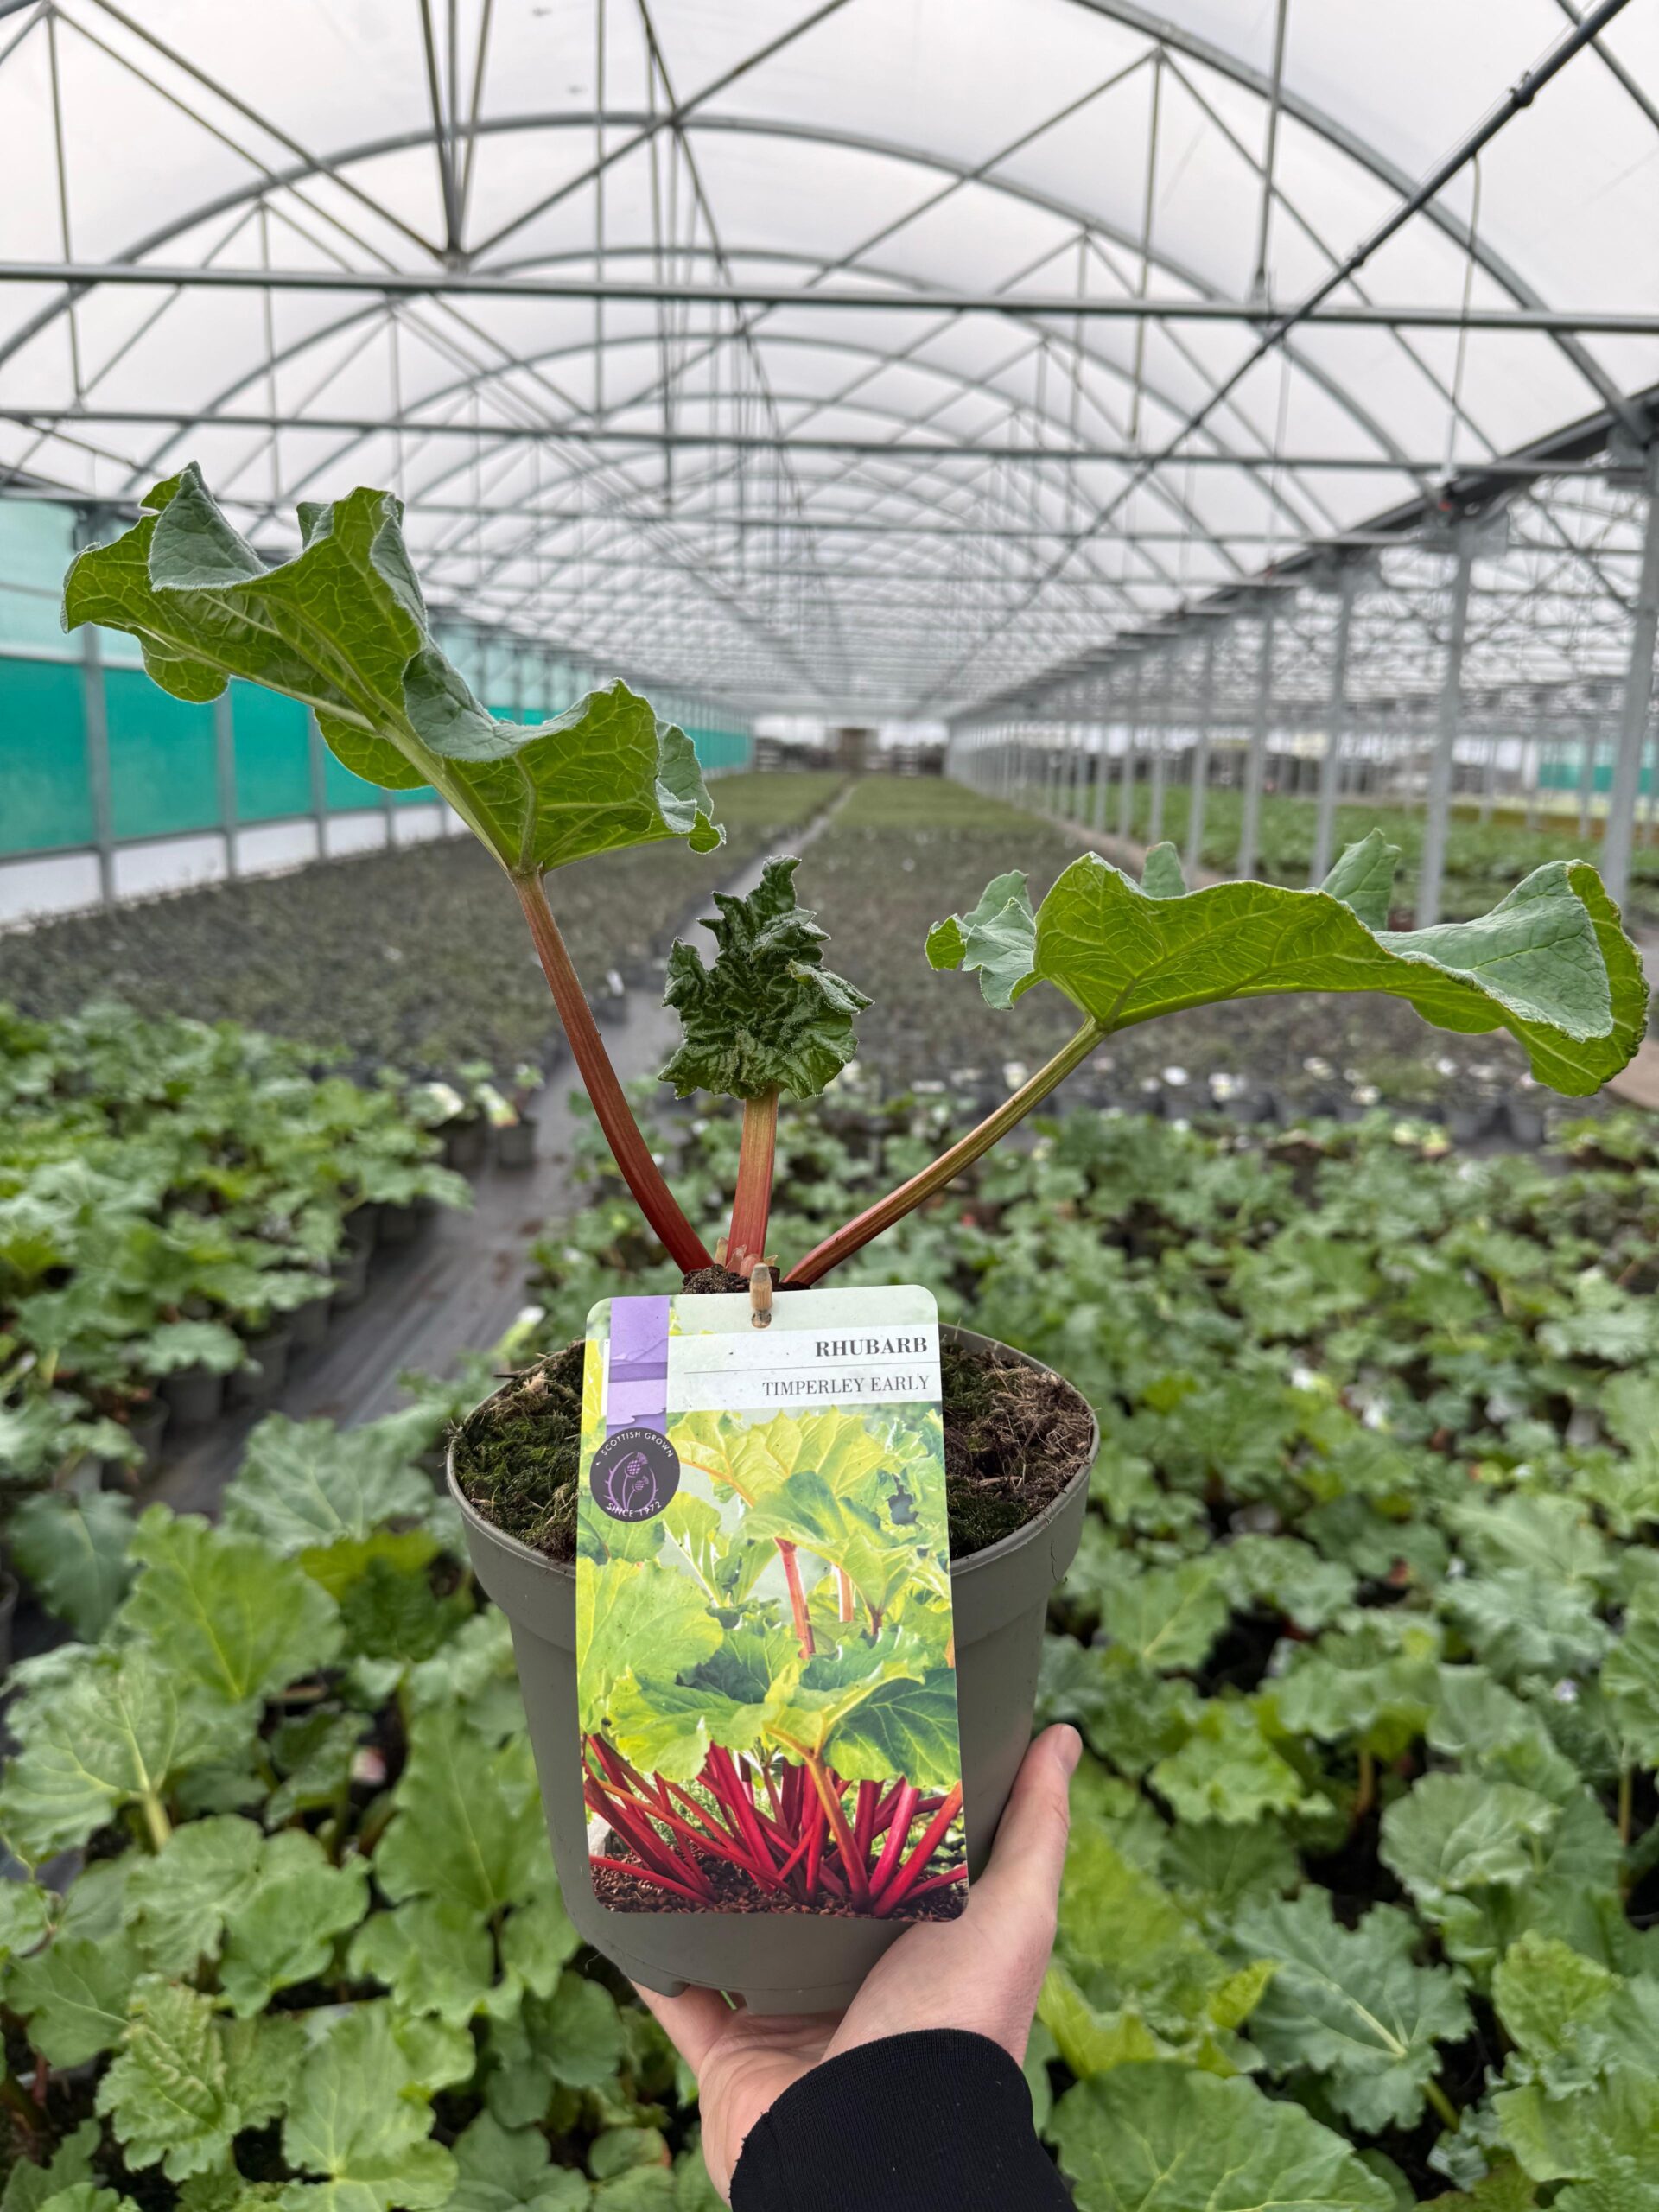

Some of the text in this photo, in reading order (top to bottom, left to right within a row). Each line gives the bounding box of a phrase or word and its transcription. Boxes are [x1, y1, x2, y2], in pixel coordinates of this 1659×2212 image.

[815, 1337, 928, 1357] RHUBARB
[762, 1375, 930, 1396] TIMPERLEY EARLY
[601, 1431, 674, 1457] SCOTTISH GROWN
[606, 1501, 662, 1517] SINCE 1972
